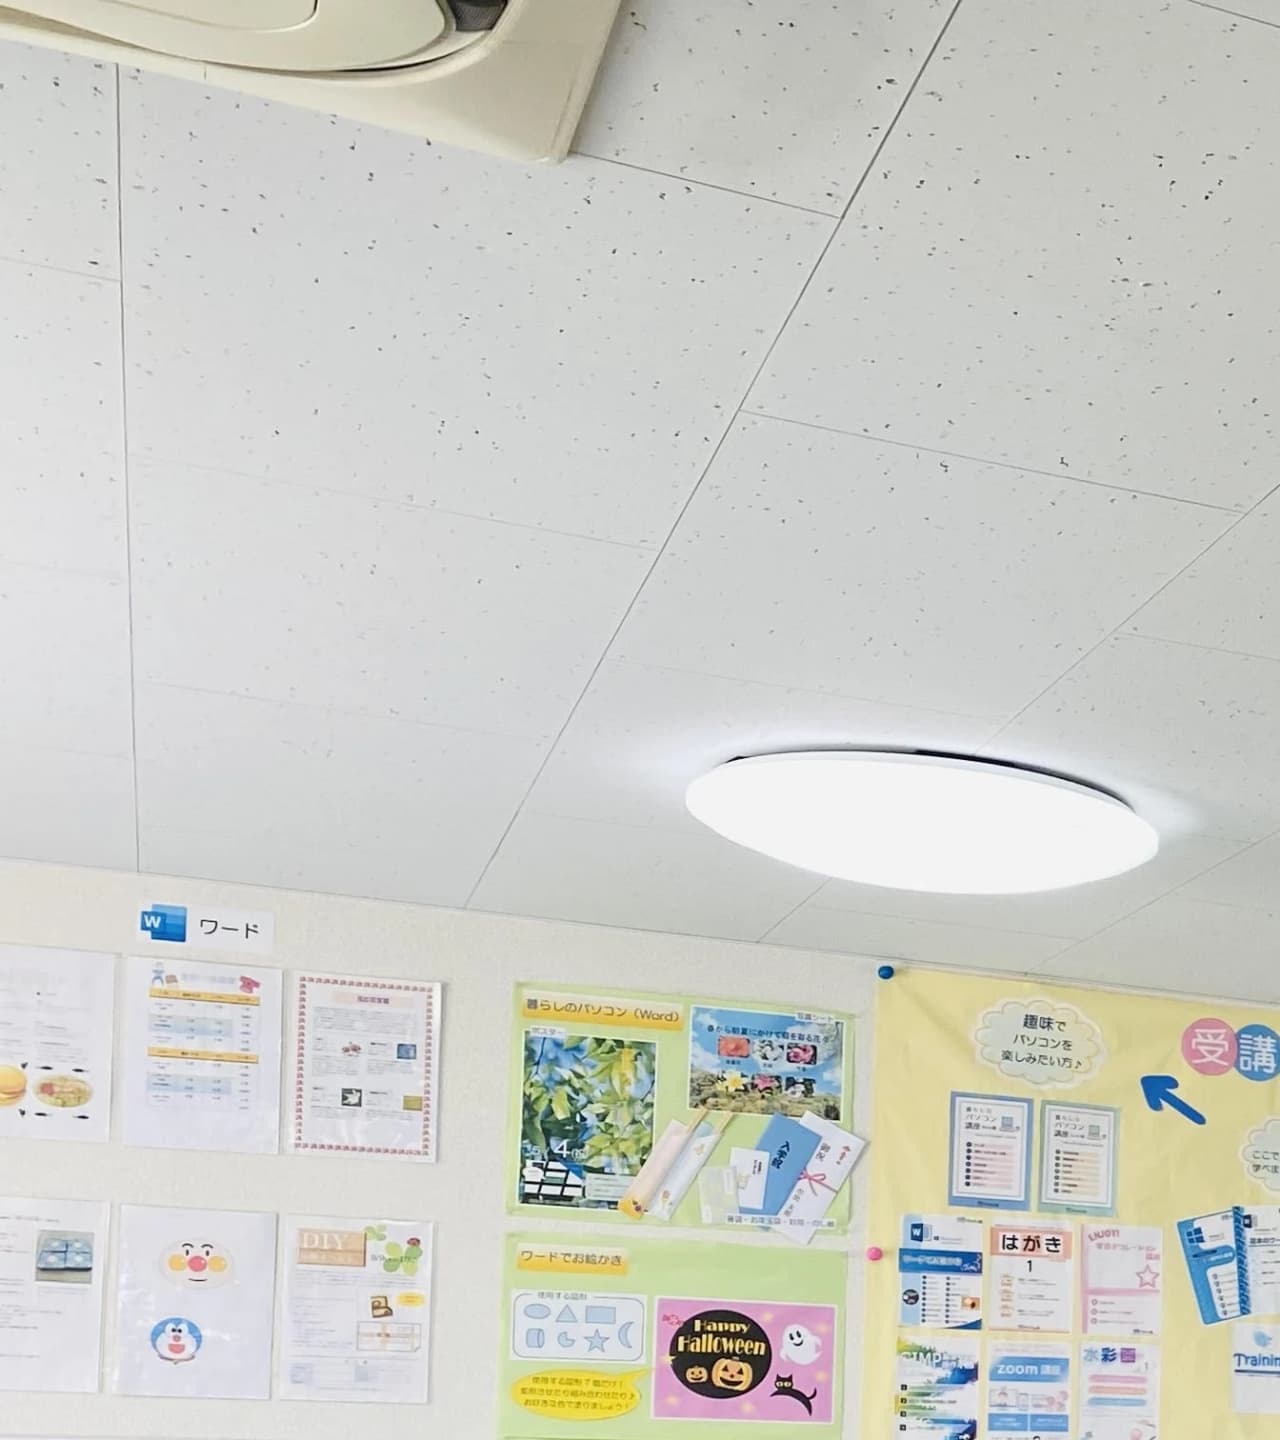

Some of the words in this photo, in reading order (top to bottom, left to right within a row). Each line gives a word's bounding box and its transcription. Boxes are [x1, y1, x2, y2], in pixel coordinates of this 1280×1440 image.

[200, 918, 260, 940] ワード
[1023, 1014, 1066, 1033] 趣味で
[1013, 1034, 1072, 1051] パソコンを
[1002, 1234, 1061, 1253] はがき
[520, 1250, 622, 1266] ワードでお絵かき
[1027, 1260, 1033, 1272] 1
[693, 1318, 750, 1334] Happy
[677, 1333, 767, 1357] Halloween
[997, 1365, 1038, 1375] zoom
